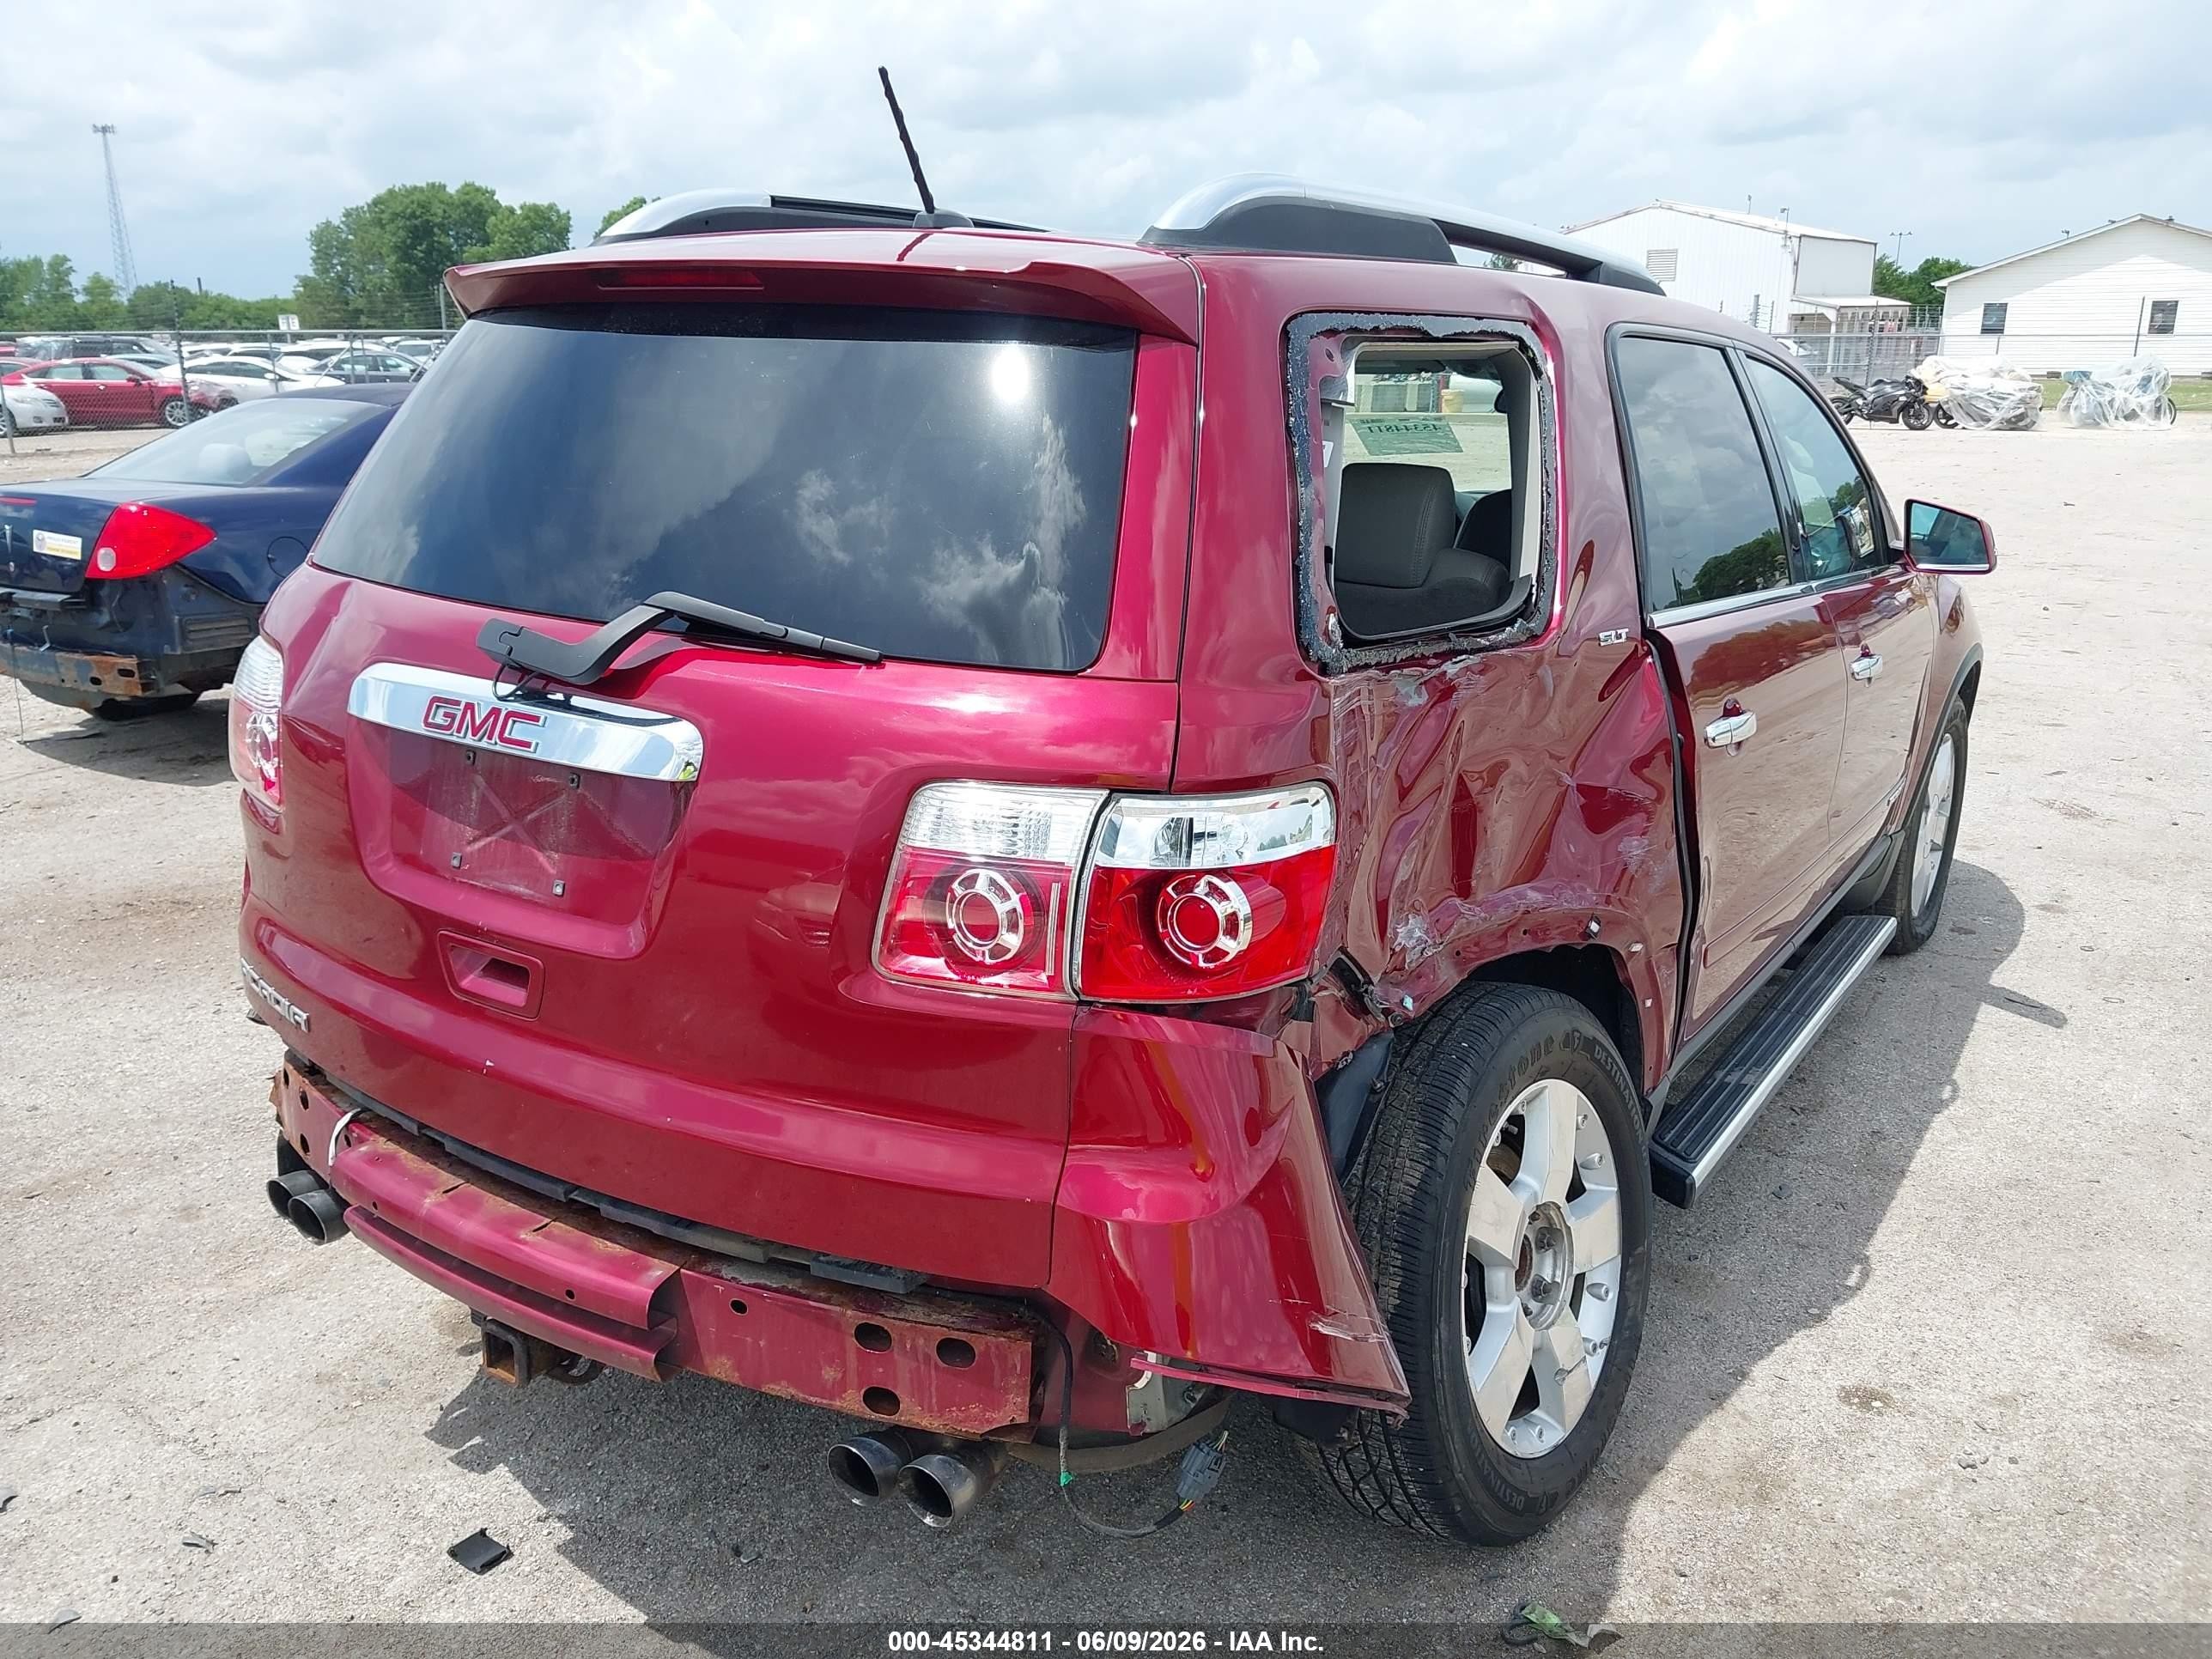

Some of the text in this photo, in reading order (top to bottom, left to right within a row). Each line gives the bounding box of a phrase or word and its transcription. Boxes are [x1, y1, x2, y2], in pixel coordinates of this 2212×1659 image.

[1599, 628, 1629, 647] SLT
[422, 695, 547, 753] GMC
[1594, 1044, 1645, 1146] DESTINATION
